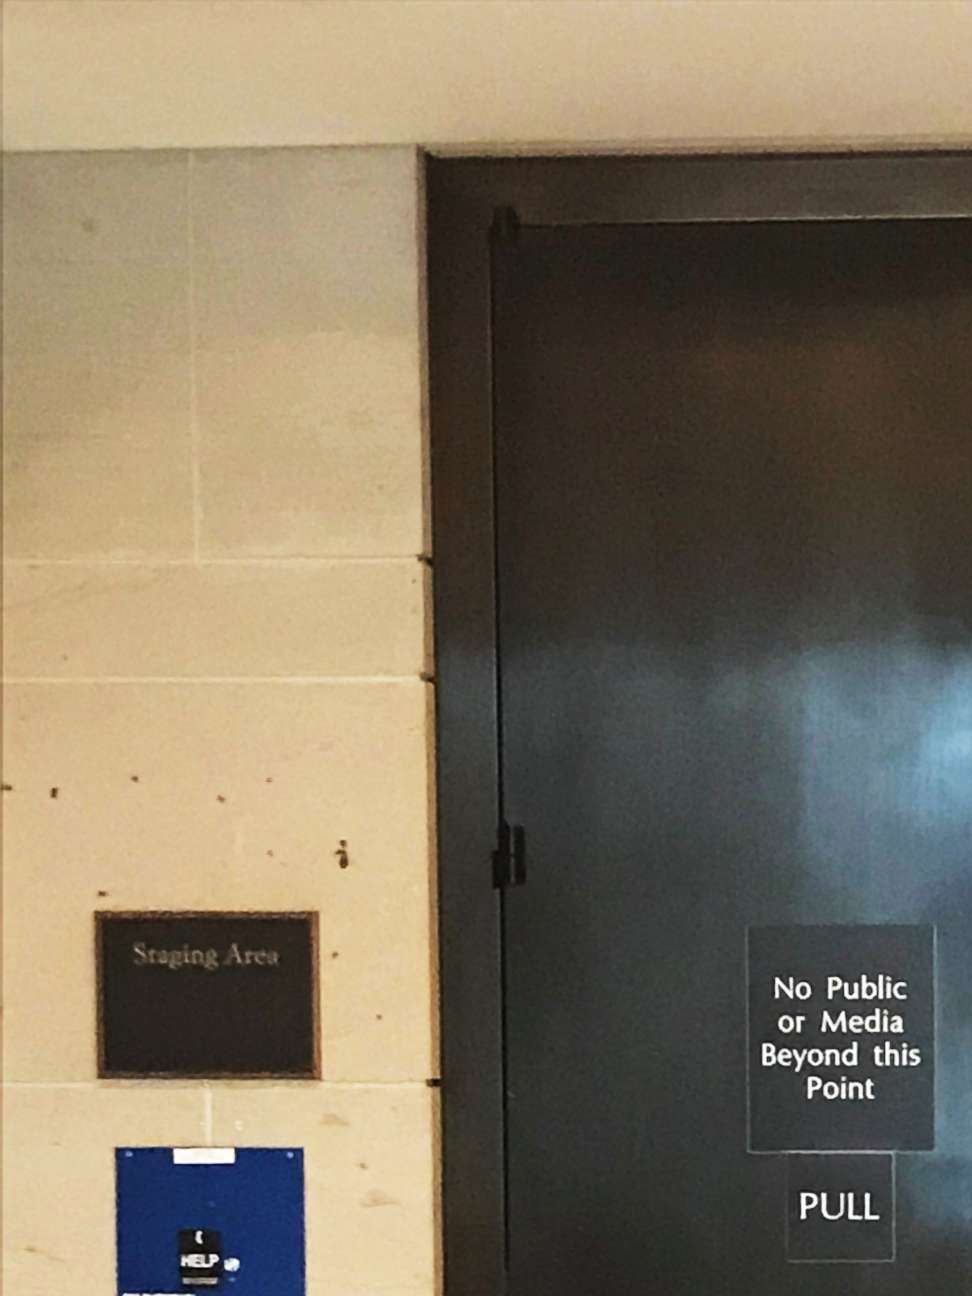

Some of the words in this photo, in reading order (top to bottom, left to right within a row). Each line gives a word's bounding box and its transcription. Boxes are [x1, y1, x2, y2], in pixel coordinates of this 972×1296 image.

[132, 942, 219, 969] Staging
[223, 942, 280, 965] Area
[774, 976, 813, 1001] No
[827, 973, 908, 1001] Public
[777, 1014, 806, 1034] or
[820, 1007, 905, 1034] Media
[761, 1040, 859, 1073] Beyond
[873, 1040, 922, 1067] this
[806, 1075, 876, 1100] Point
[799, 1191, 881, 1221] PULL
[180, 1253, 220, 1268] HELP
